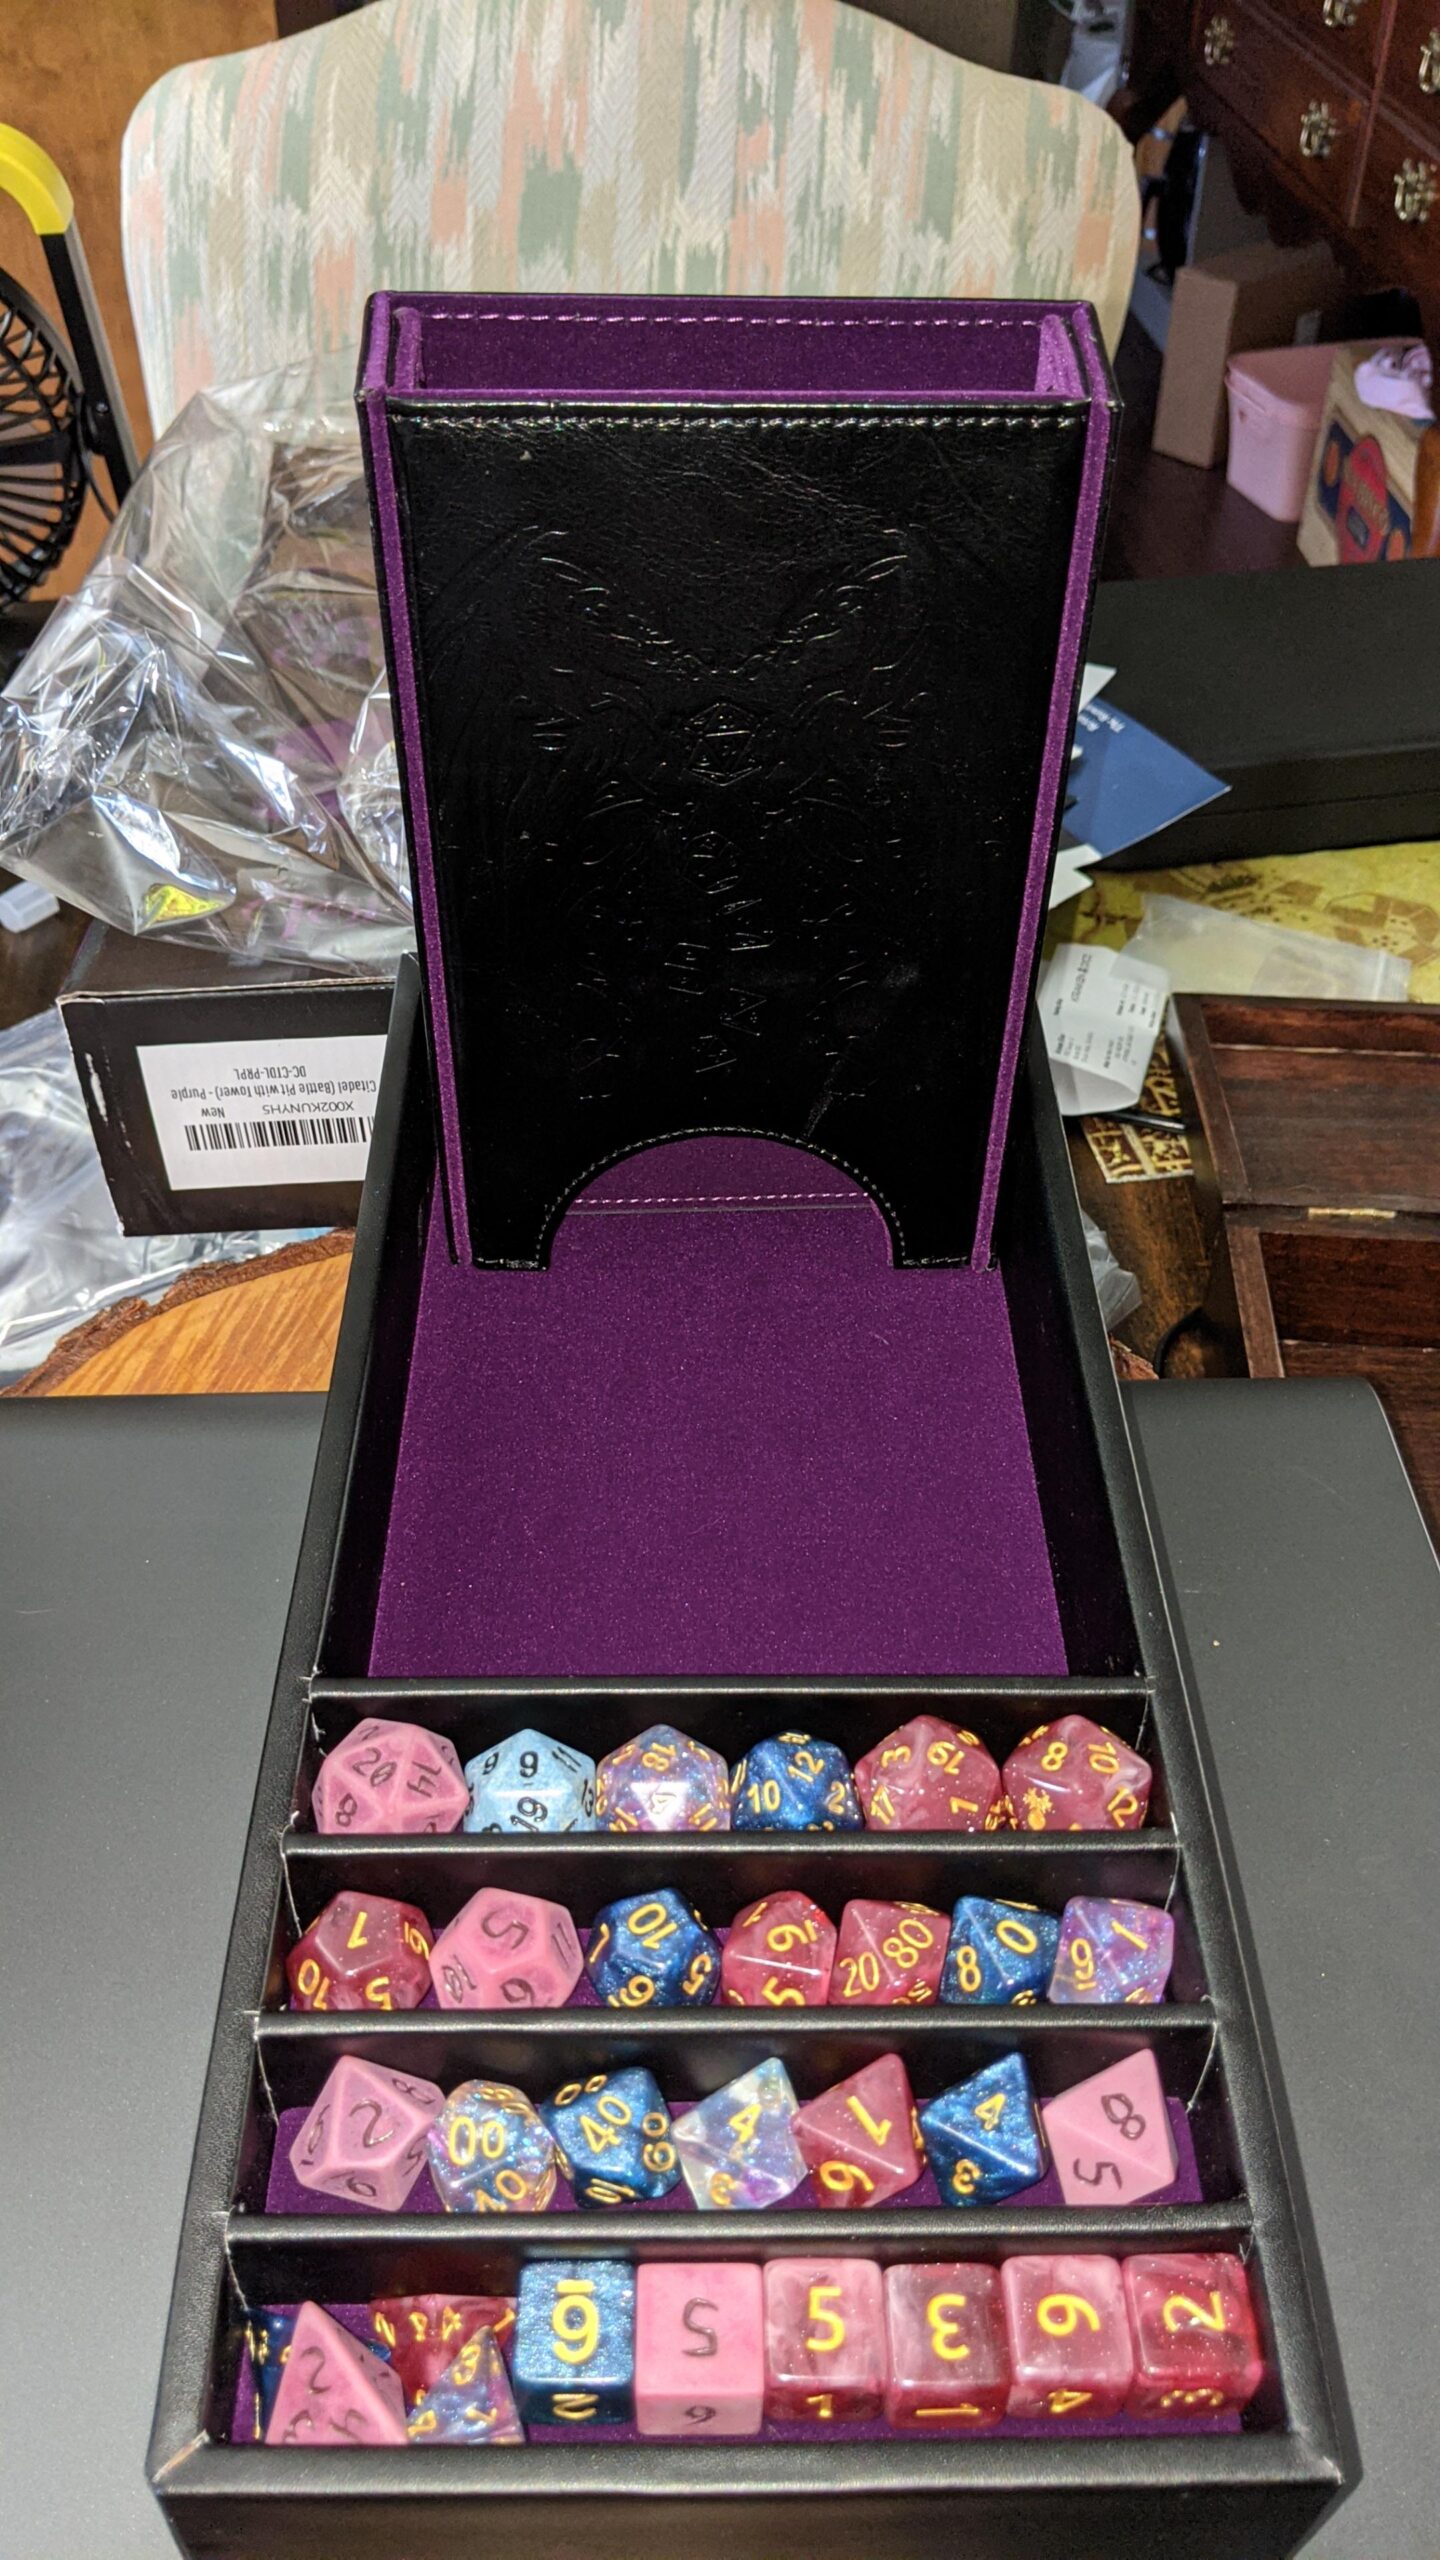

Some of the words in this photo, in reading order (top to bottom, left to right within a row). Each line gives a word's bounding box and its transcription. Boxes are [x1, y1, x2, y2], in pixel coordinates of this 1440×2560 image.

[233, 1065, 307, 1080] DC-CTDL-PRPL
[280, 1083, 296, 1097] Pit
[299, 1081, 336, 1096] (Battle
[338, 1080, 377, 1094] Citadel
[170, 1086, 207, 1101] Purple
[214, 1085, 252, 1101] Tower)
[254, 1084, 280, 1098] with
[201, 1106, 225, 1118] New
[352, 1747, 397, 1787] 20
[642, 1742, 677, 1772] 18
[788, 1751, 825, 1783] 12
[881, 1745, 911, 1769] 3
[1041, 1741, 1068, 1771] 8
[1087, 1741, 1120, 1774] 10
[335, 1792, 358, 1827] 8
[510, 1797, 548, 1832] 19
[747, 1780, 780, 1814] 10
[827, 1781, 846, 1815] 2
[1107, 1790, 1138, 1828] 12
[627, 1903, 678, 1950] 10
[883, 1918, 934, 1969] 80
[996, 1919, 1038, 1955] 0
[1111, 1919, 1148, 1951] 1
[682, 1953, 712, 1996] 5
[840, 1952, 880, 1998] 20
[957, 1945, 982, 1993] 8
[1071, 1938, 1097, 1990] 9
[298, 1958, 331, 2010] 10
[365, 1976, 393, 2010] 5
[762, 1976, 806, 2006] 5
[350, 2099, 394, 2147] 2
[578, 2095, 632, 2154] 40
[729, 2103, 762, 2144] 4
[846, 2095, 893, 2146] 1
[974, 2092, 1007, 2131] 4
[1101, 2093, 1146, 2141] 8
[448, 2115, 506, 2167] 00
[952, 2158, 982, 2195] 3
[805, 2285, 847, 2352] 5
[926, 2292, 971, 2361] 3
[1162, 2291, 1226, 2333] 2
[300, 2346, 332, 2395] 2
[806, 2393, 833, 2419] 1
